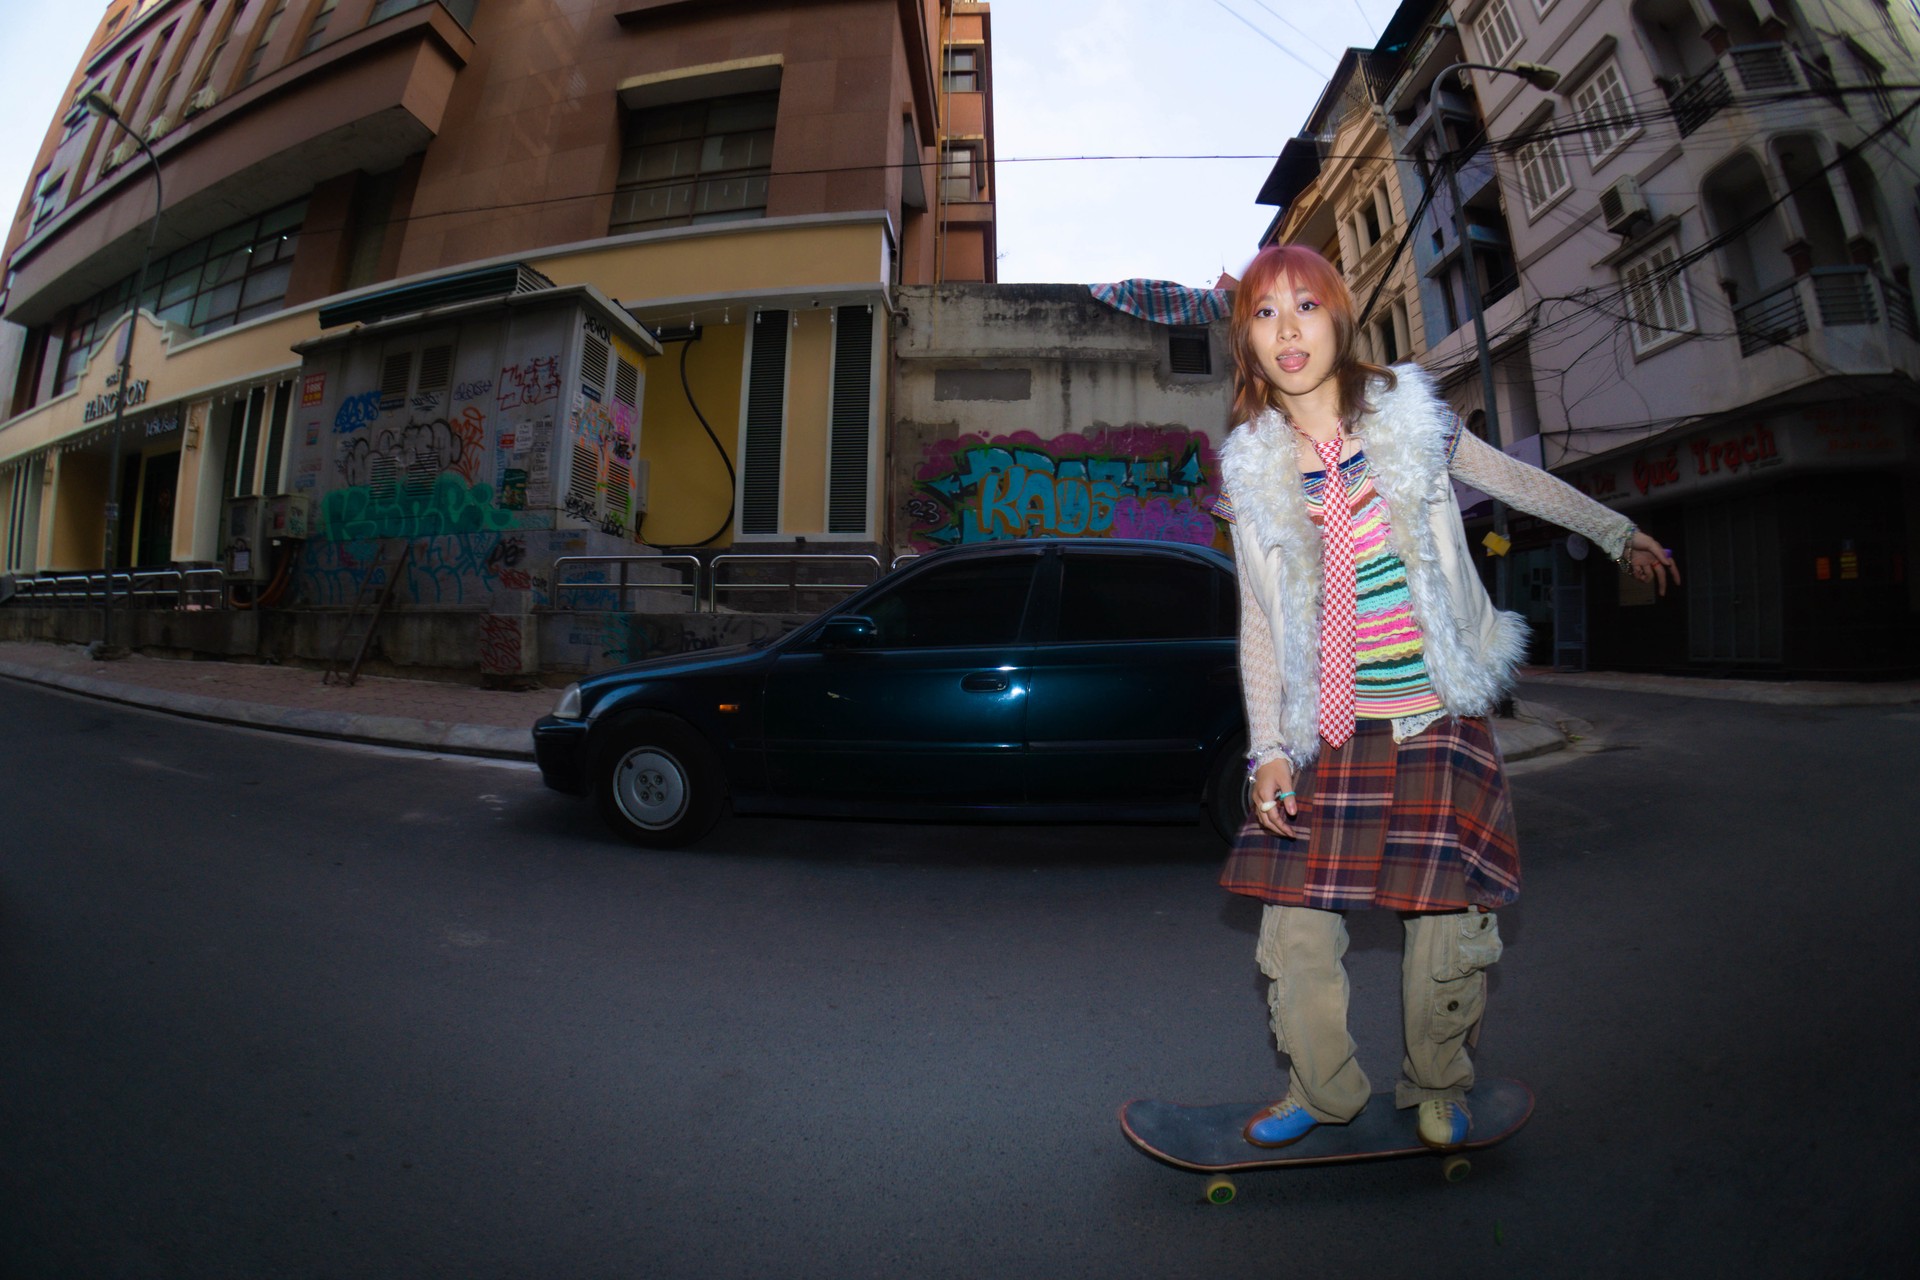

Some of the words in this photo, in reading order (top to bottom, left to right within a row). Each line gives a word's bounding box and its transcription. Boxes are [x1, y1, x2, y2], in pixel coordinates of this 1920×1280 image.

[1632, 445, 1680, 496] Quế
[1690, 421, 1778, 475] Trạch
[909, 499, 941, 525] 23
